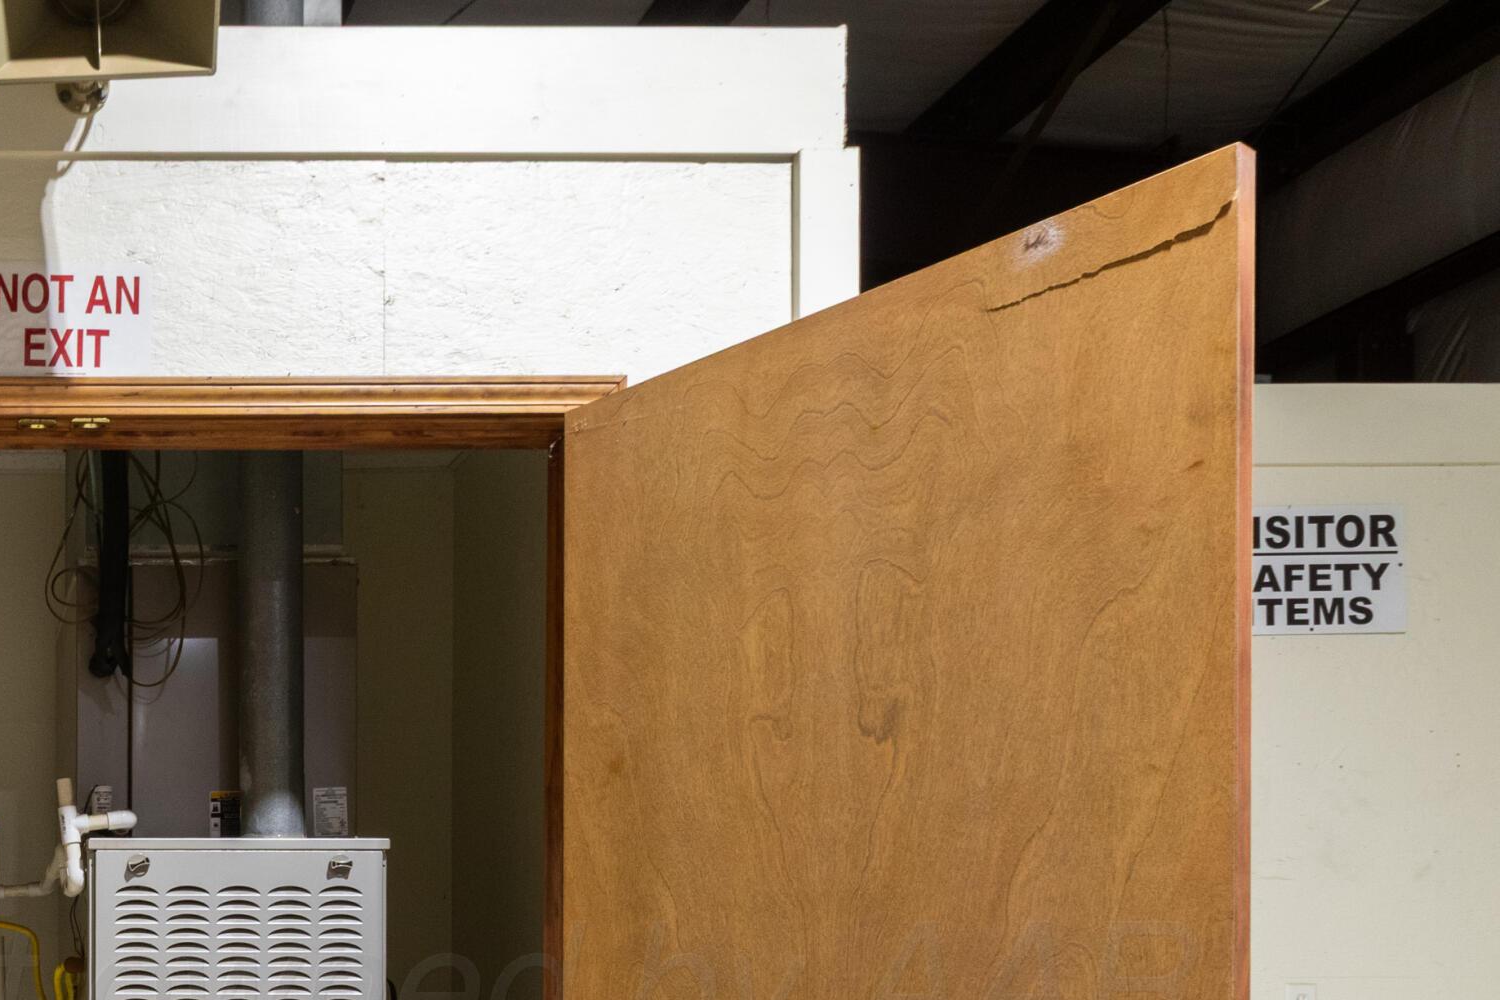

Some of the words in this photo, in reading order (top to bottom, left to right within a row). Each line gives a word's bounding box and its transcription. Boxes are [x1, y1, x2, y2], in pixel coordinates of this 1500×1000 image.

[85, 275, 140, 315] AN
[23, 327, 110, 368] EXIT
[1253, 514, 1398, 549] ISITOR
[1253, 562, 1390, 592] AFETY
[1252, 596, 1374, 626] TEMS
